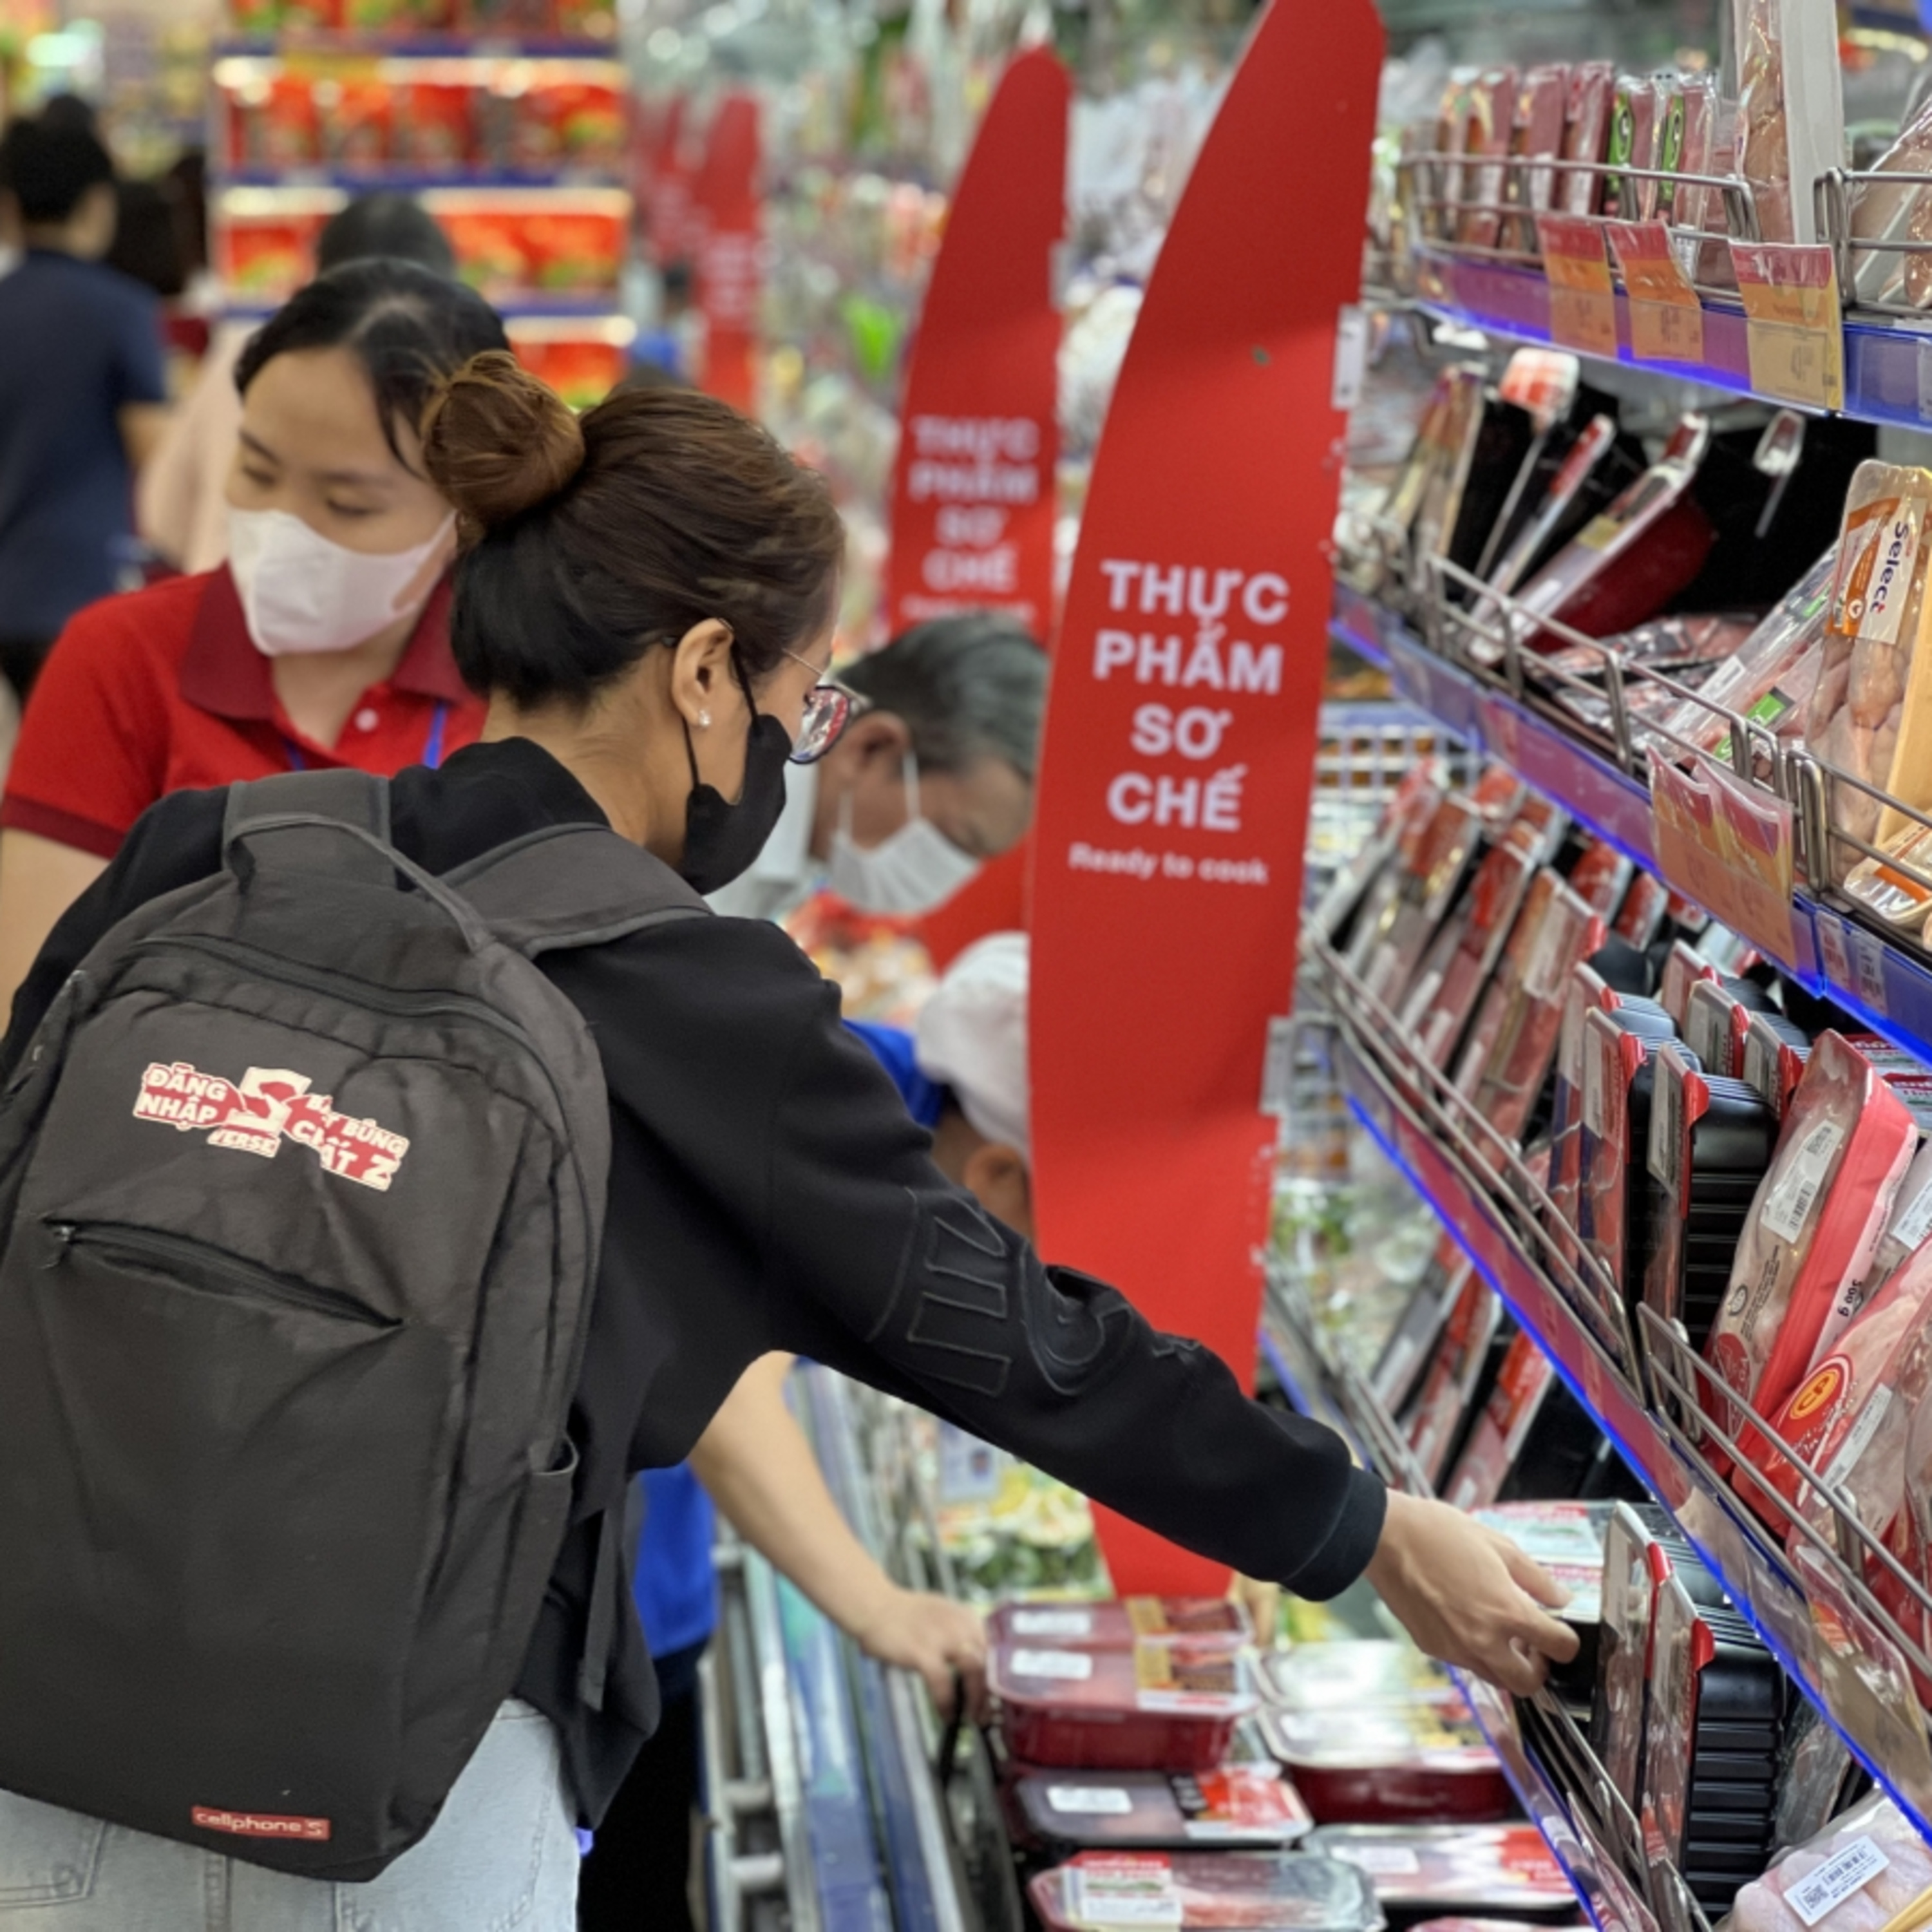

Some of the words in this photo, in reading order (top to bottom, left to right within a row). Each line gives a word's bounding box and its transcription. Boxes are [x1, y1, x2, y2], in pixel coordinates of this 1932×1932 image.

[1870, 522, 1909, 612] Select
[1100, 558, 1289, 628] THỰC
[1093, 621, 1282, 696] PHẨM
[1131, 703, 1233, 760] SƠ
[1106, 764, 1247, 831] CHẾ
[1068, 841, 1158, 881] Ready
[1162, 850, 1194, 878] to
[146, 1065, 228, 1102] ĐĂNG
[139, 1093, 218, 1130] NHẬP
[212, 1129, 278, 1154] VERSE
[362, 1153, 399, 1191] Z
